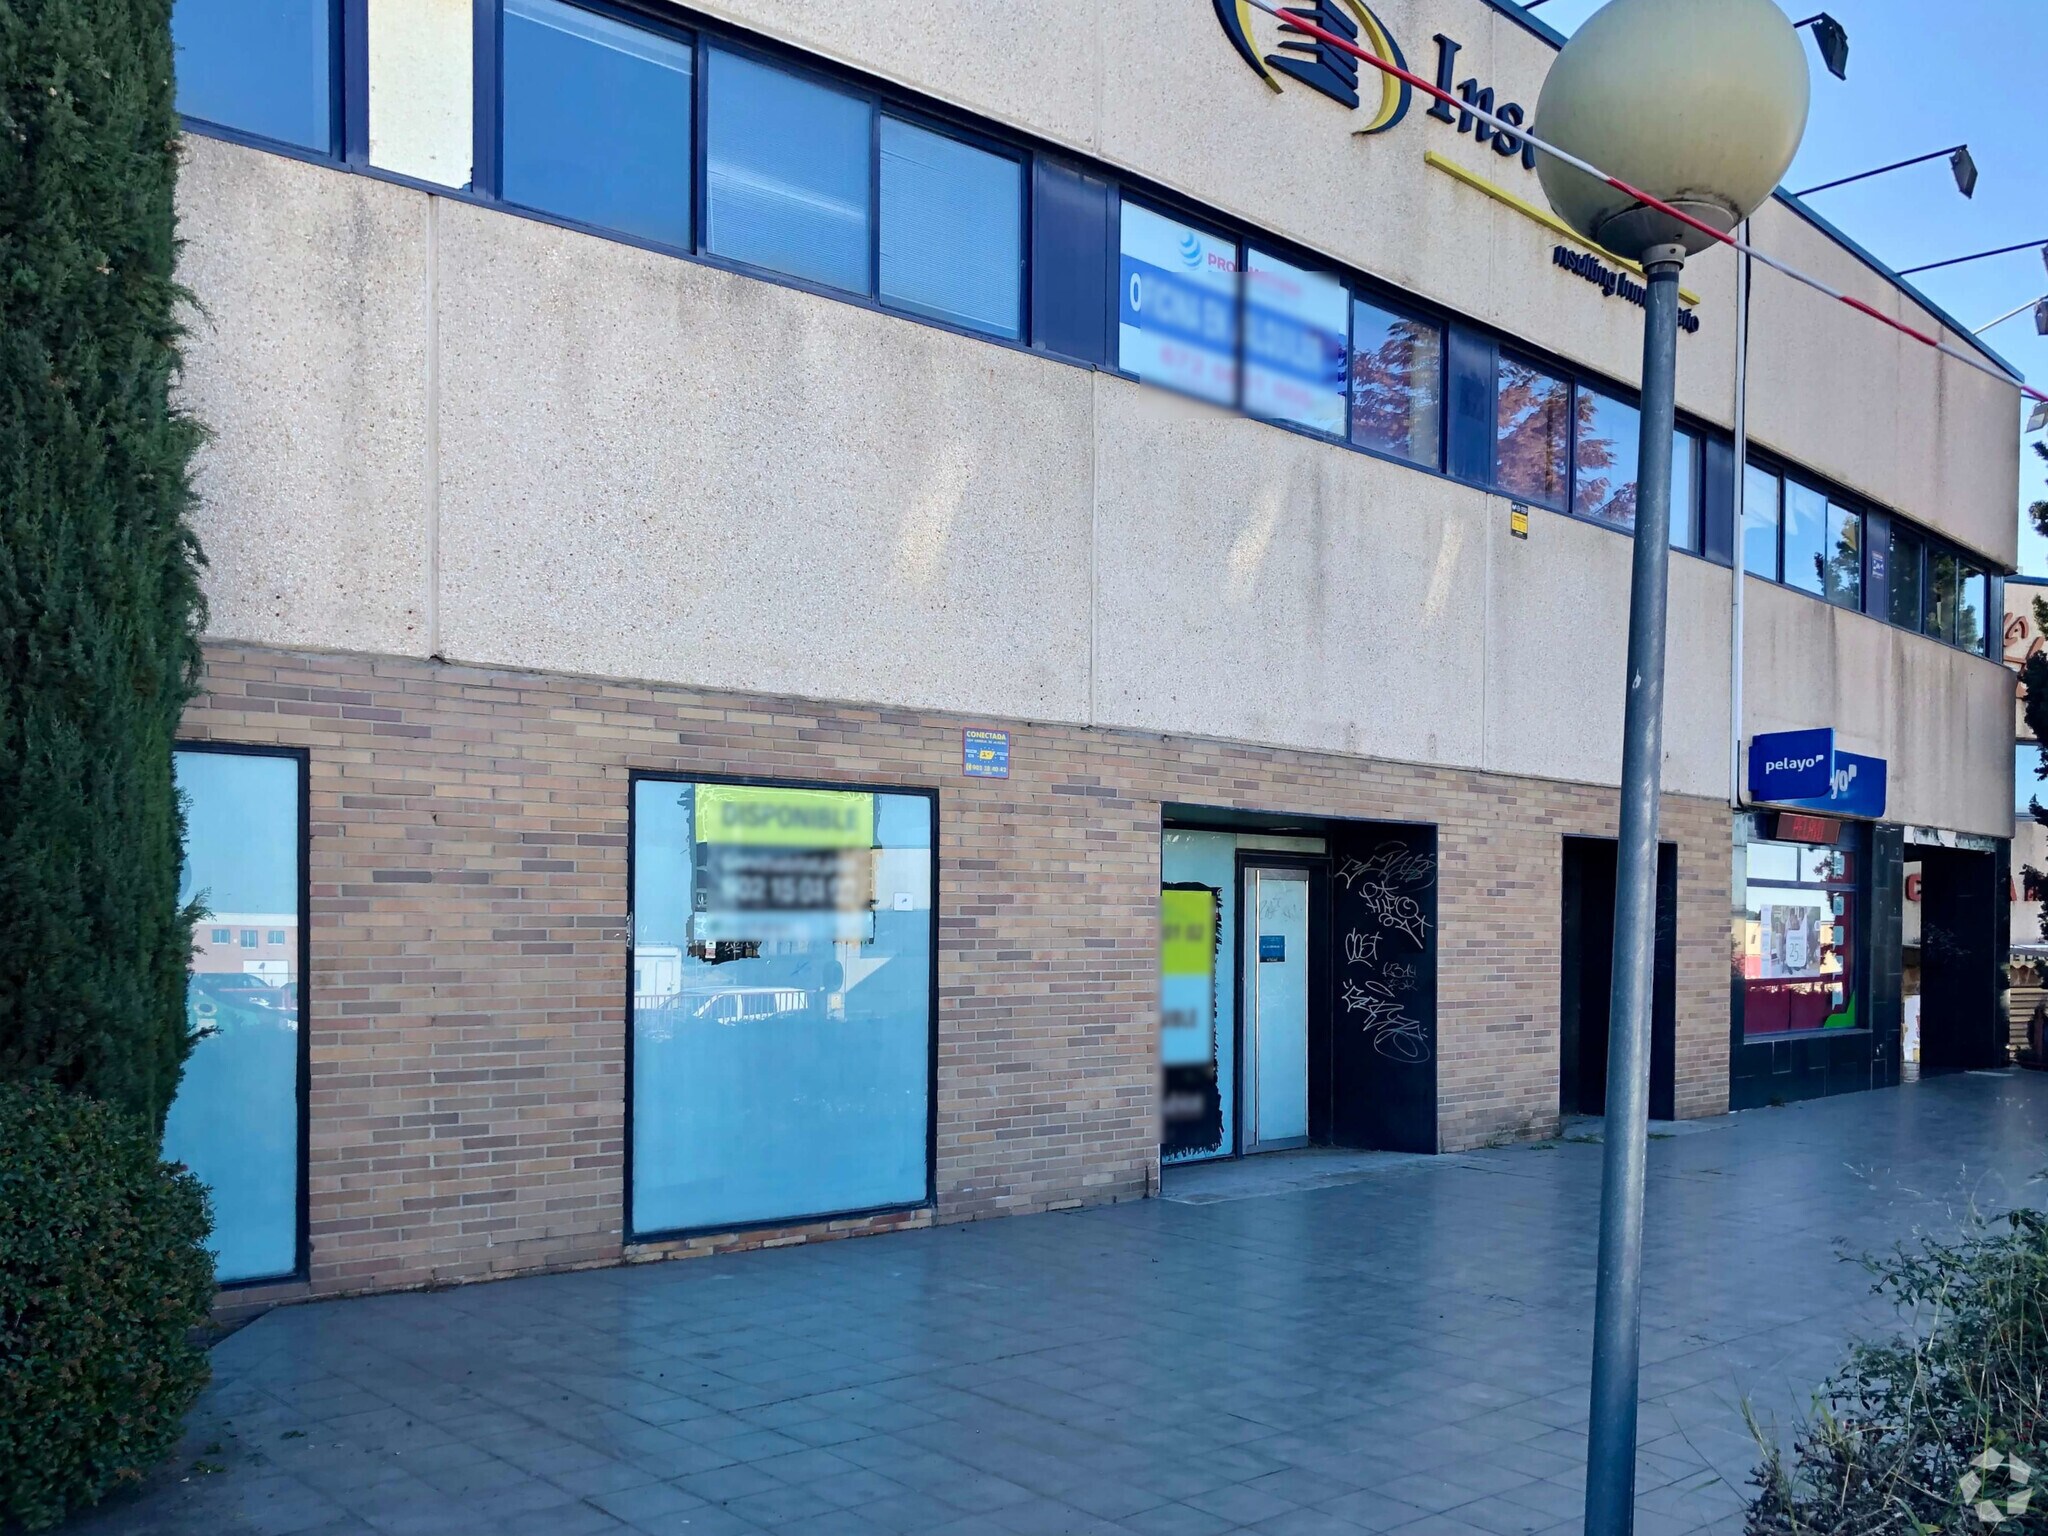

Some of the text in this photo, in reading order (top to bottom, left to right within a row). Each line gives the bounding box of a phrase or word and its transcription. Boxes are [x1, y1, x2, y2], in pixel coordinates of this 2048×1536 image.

[1426, 33, 1536, 170] Ins
[966, 730, 1006, 740] CONECTADA
[1765, 757, 1815, 775] pelayo
